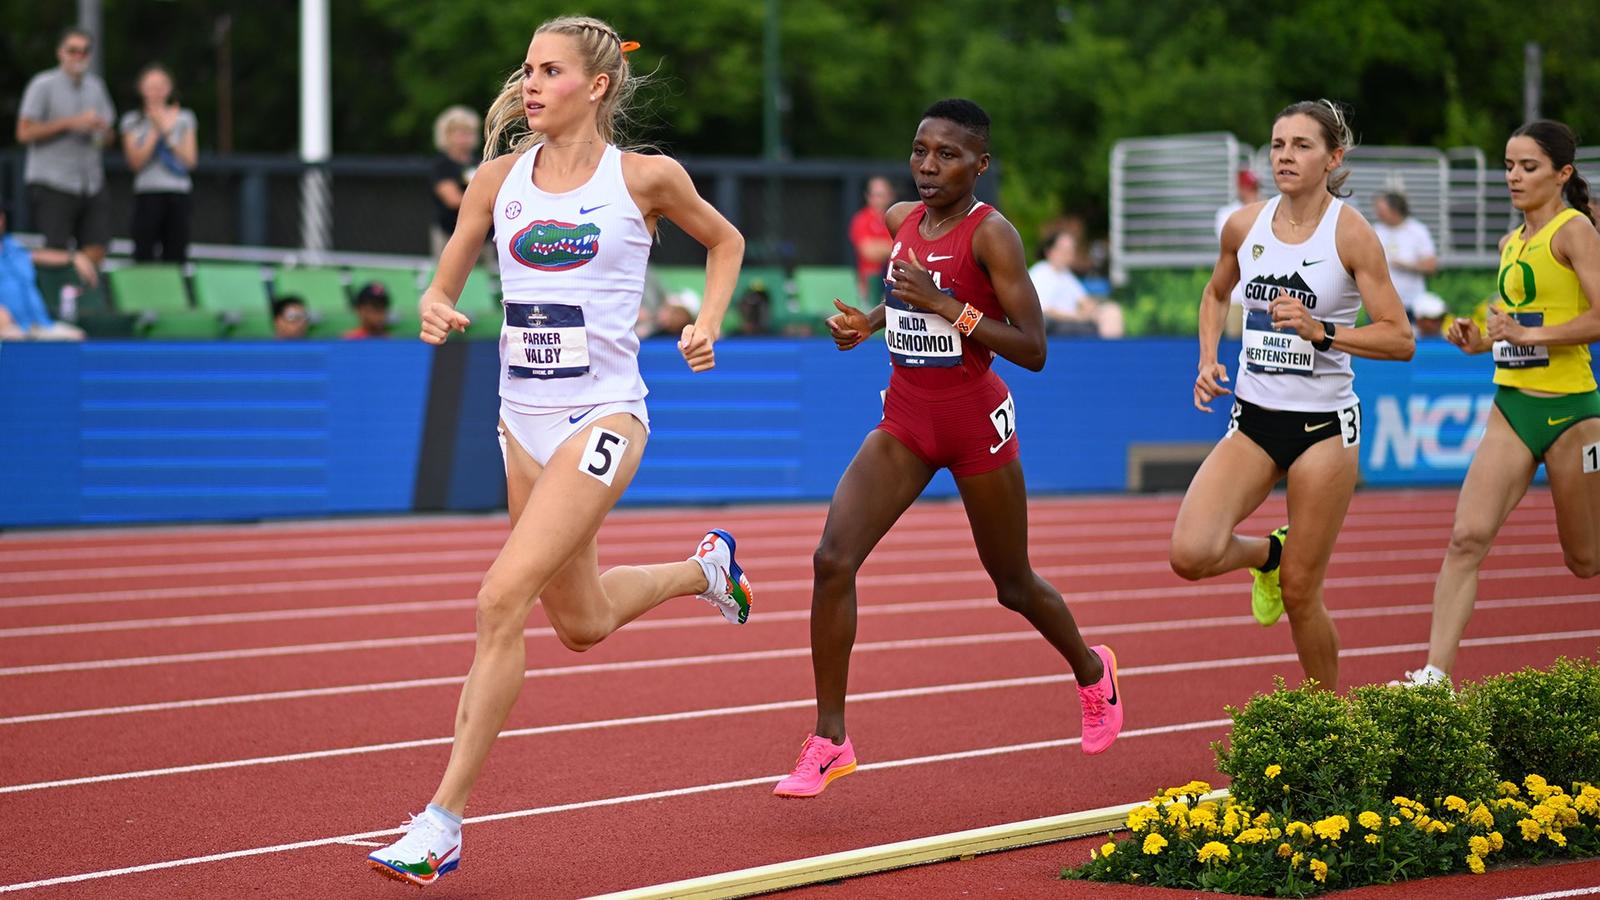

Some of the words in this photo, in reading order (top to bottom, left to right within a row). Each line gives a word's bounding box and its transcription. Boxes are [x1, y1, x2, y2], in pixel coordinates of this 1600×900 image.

[1245, 283, 1318, 310] COLOADO
[898, 315, 927, 332] HILDA
[523, 331, 562, 345] PARKER
[887, 329, 954, 353] OLEMOMOI
[1262, 335, 1292, 349] BAILEY
[525, 348, 562, 364] VALBY
[1246, 346, 1312, 366] HERTENSTEIN
[994, 408, 1014, 440] 2
[1343, 407, 1358, 444] 3
[587, 432, 621, 476] 5
